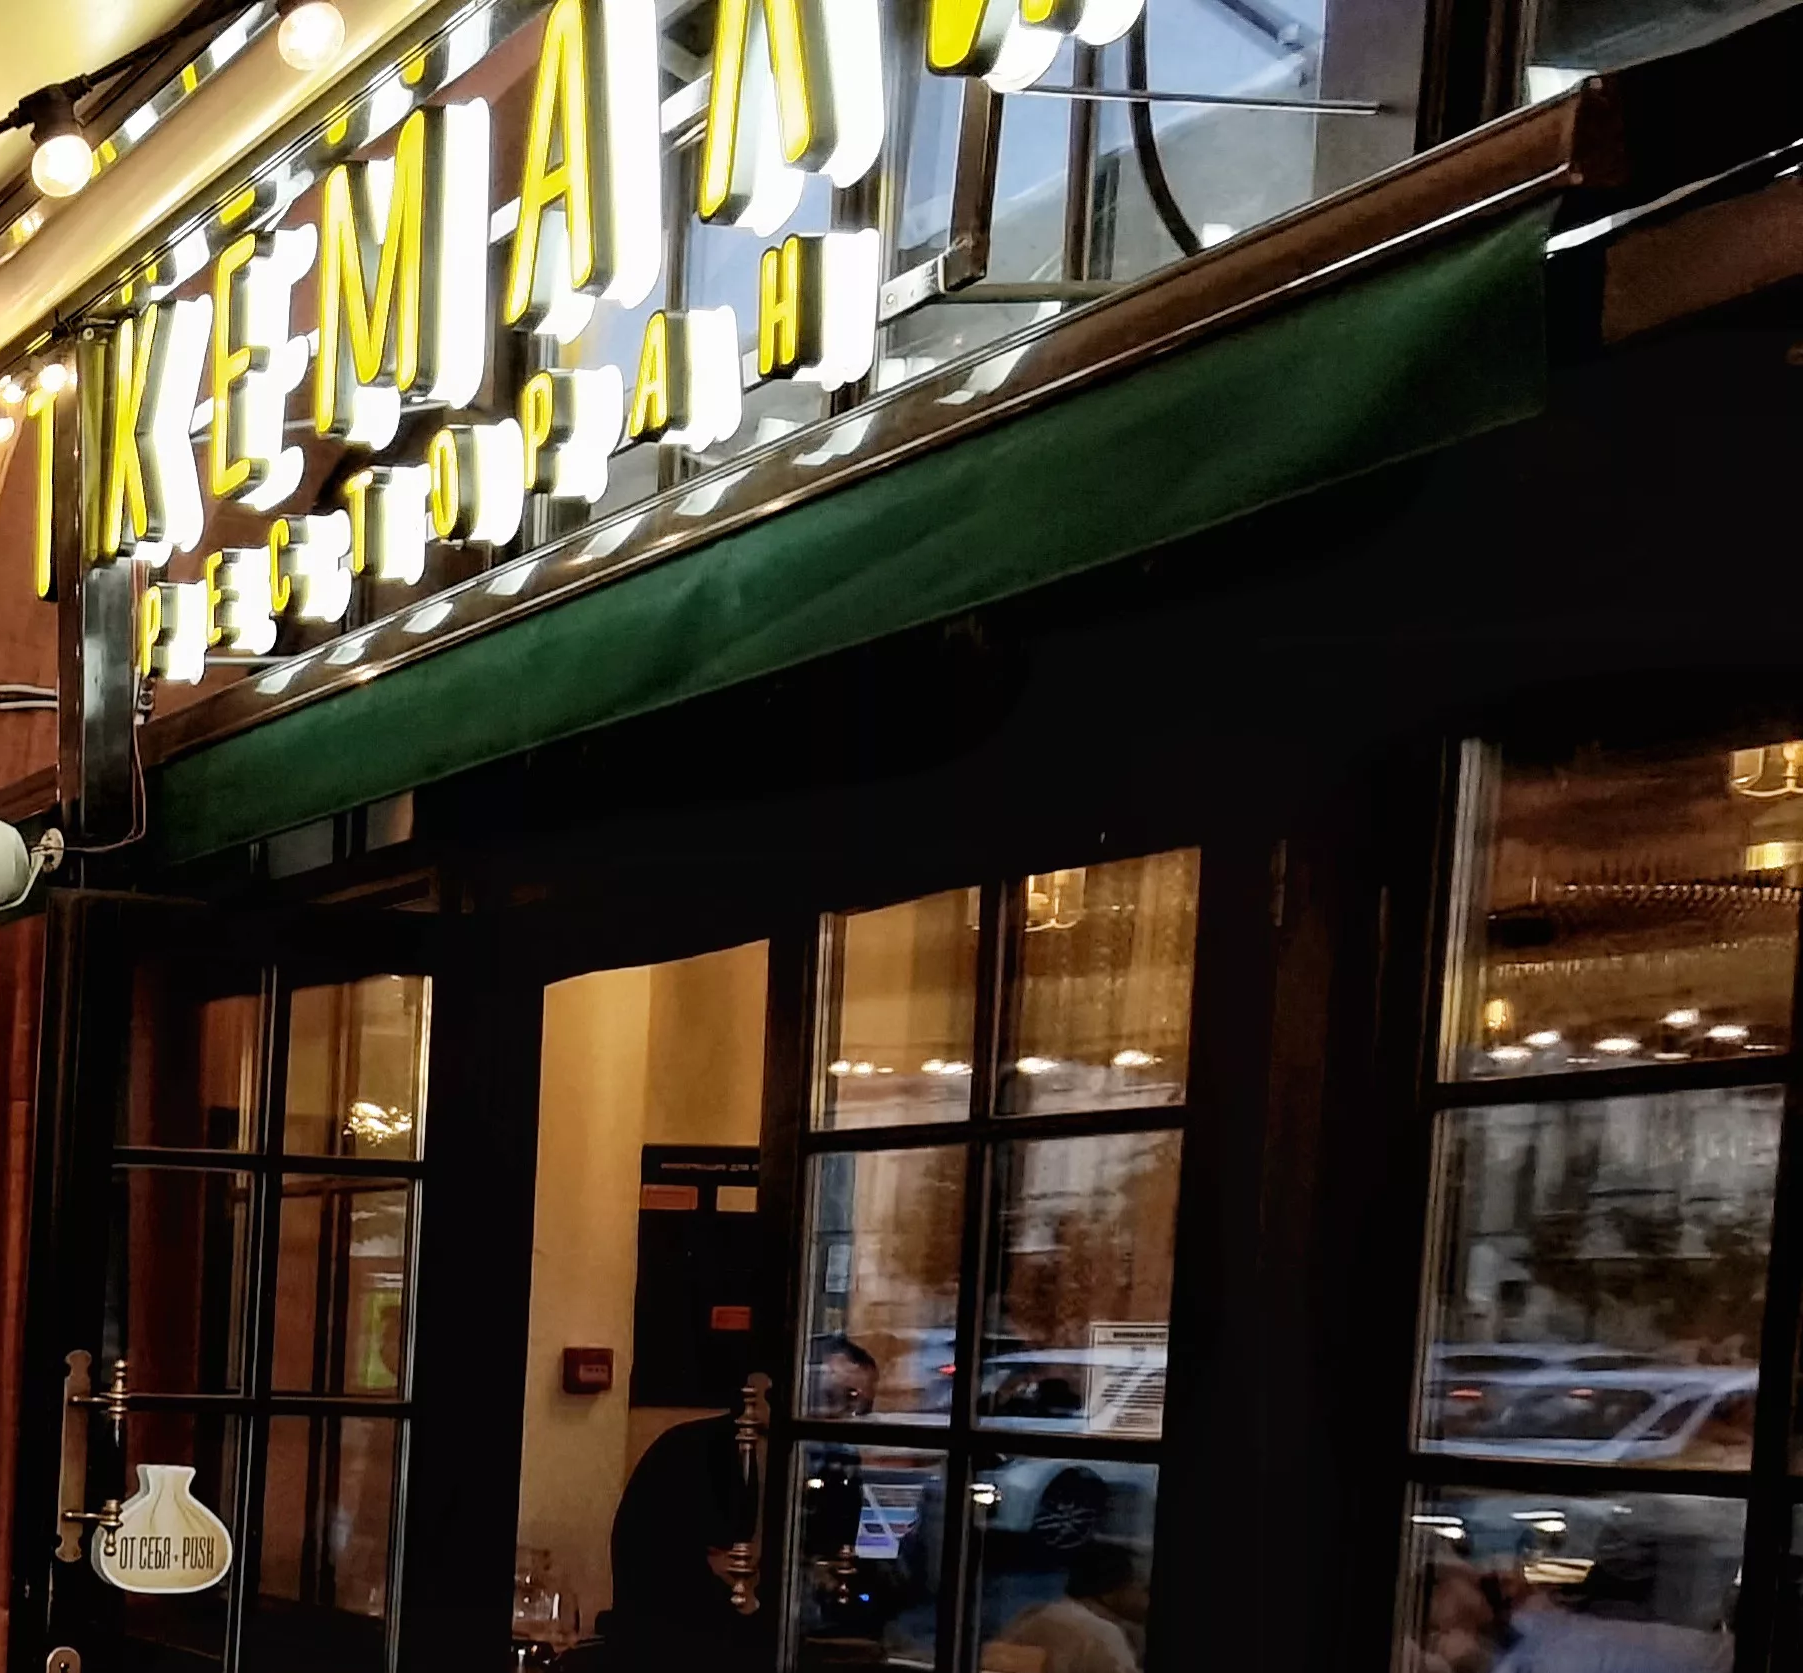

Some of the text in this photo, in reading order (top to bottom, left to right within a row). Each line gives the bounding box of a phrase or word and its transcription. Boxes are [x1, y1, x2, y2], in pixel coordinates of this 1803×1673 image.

[26, 0, 1058, 600] ТКЕМАЛ
[137, 234, 801, 677] РЕСТОРАН
[118, 1536, 171, 1570] ОТ СЕБЯ
[182, 1536, 215, 1570] PUSH
